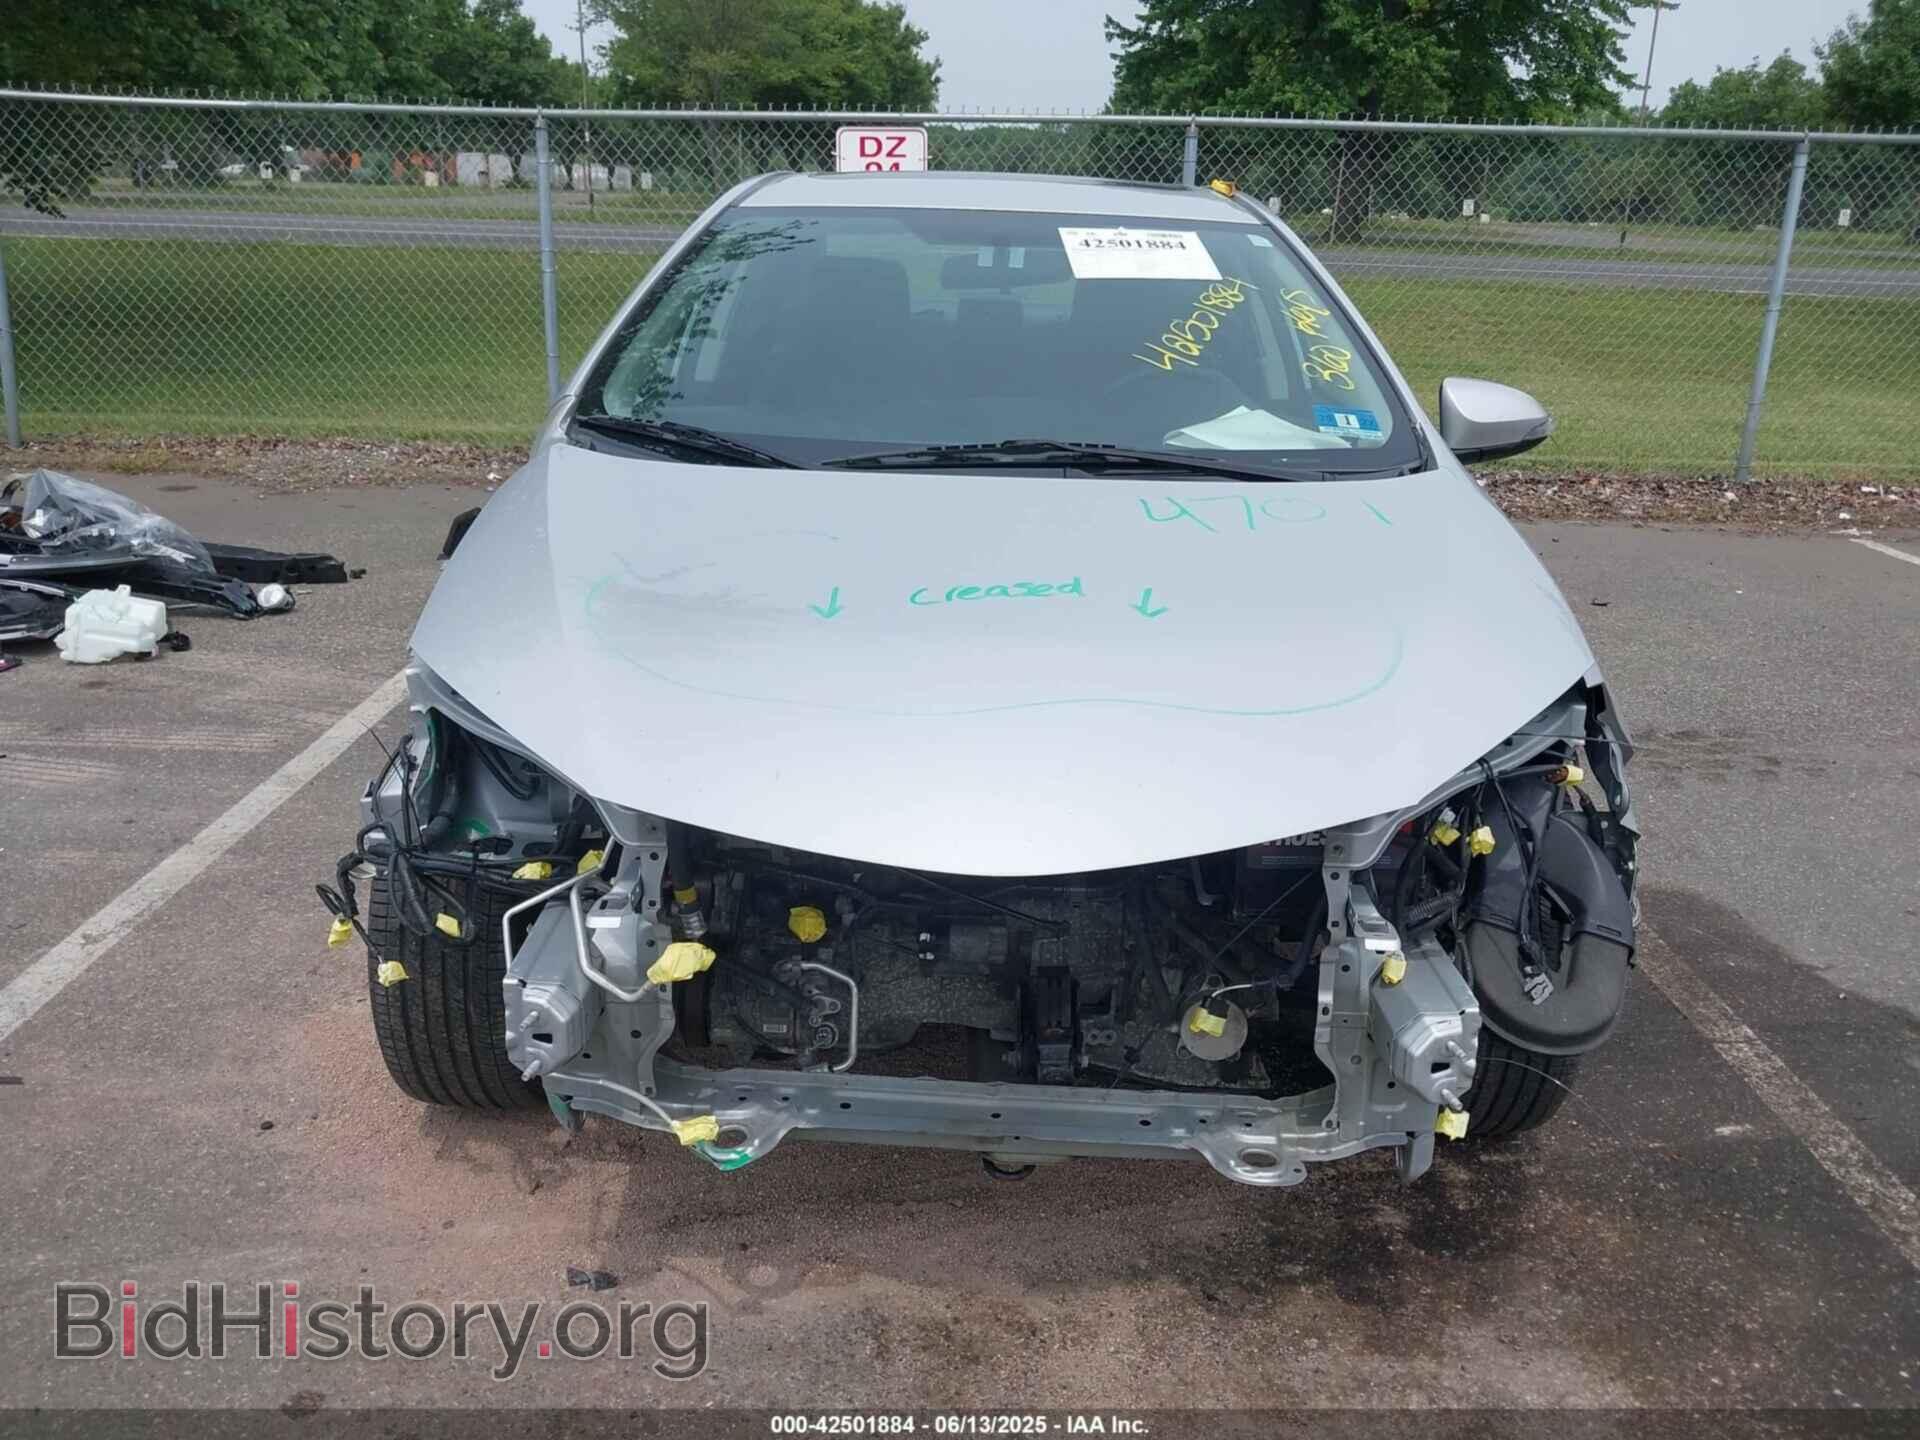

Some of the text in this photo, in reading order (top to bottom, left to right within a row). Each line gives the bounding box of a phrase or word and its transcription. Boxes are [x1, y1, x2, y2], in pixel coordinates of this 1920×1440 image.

[859, 136, 907, 158] DZ
[1079, 239, 1187, 251] 42501884
[909, 576, 1086, 606] creased
